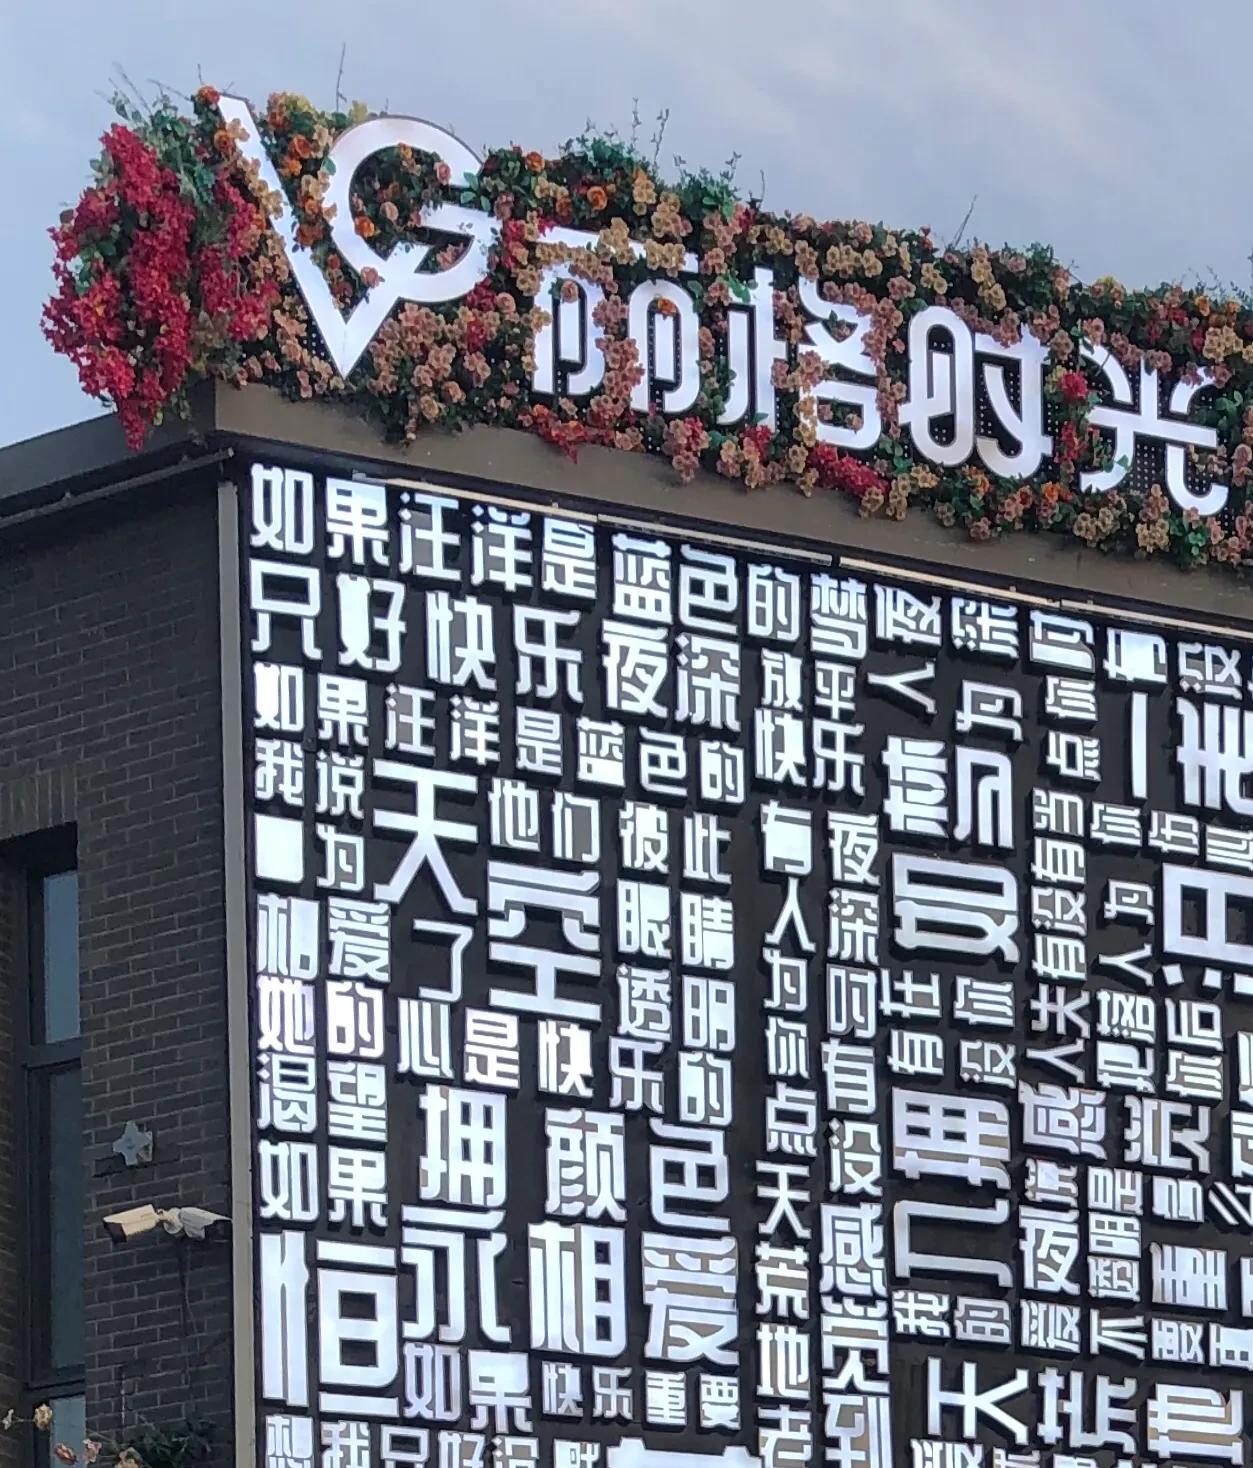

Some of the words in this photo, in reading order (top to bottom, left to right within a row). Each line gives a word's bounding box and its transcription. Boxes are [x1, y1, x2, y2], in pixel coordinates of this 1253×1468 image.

[254, 660, 744, 808] 如果汪洋是蓝色的
